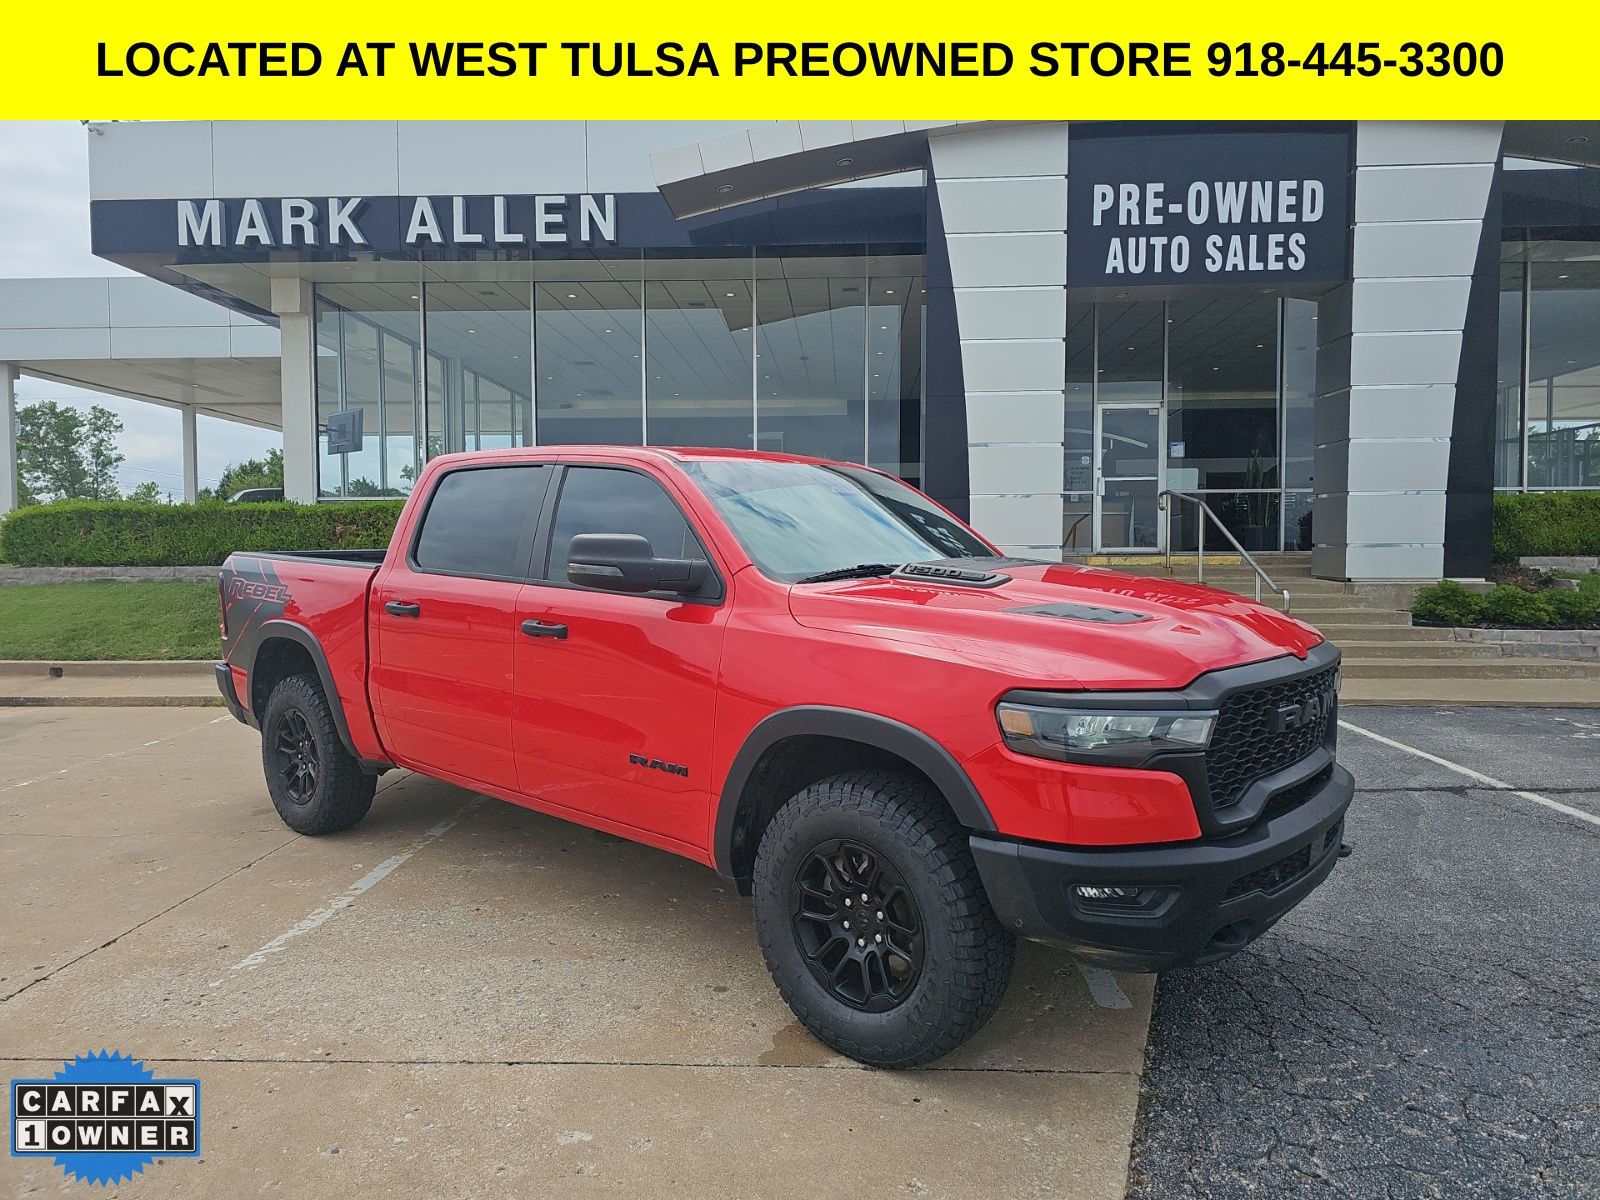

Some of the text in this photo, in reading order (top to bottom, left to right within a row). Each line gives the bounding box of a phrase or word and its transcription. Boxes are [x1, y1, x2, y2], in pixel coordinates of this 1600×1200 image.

[177, 194, 617, 247] MARK ALLEN
[1092, 179, 1325, 226] PRE-OWNED
[1104, 232, 1306, 274] AUTO SALES
[228, 577, 292, 603] REBEL
[629, 753, 688, 777] RAM
